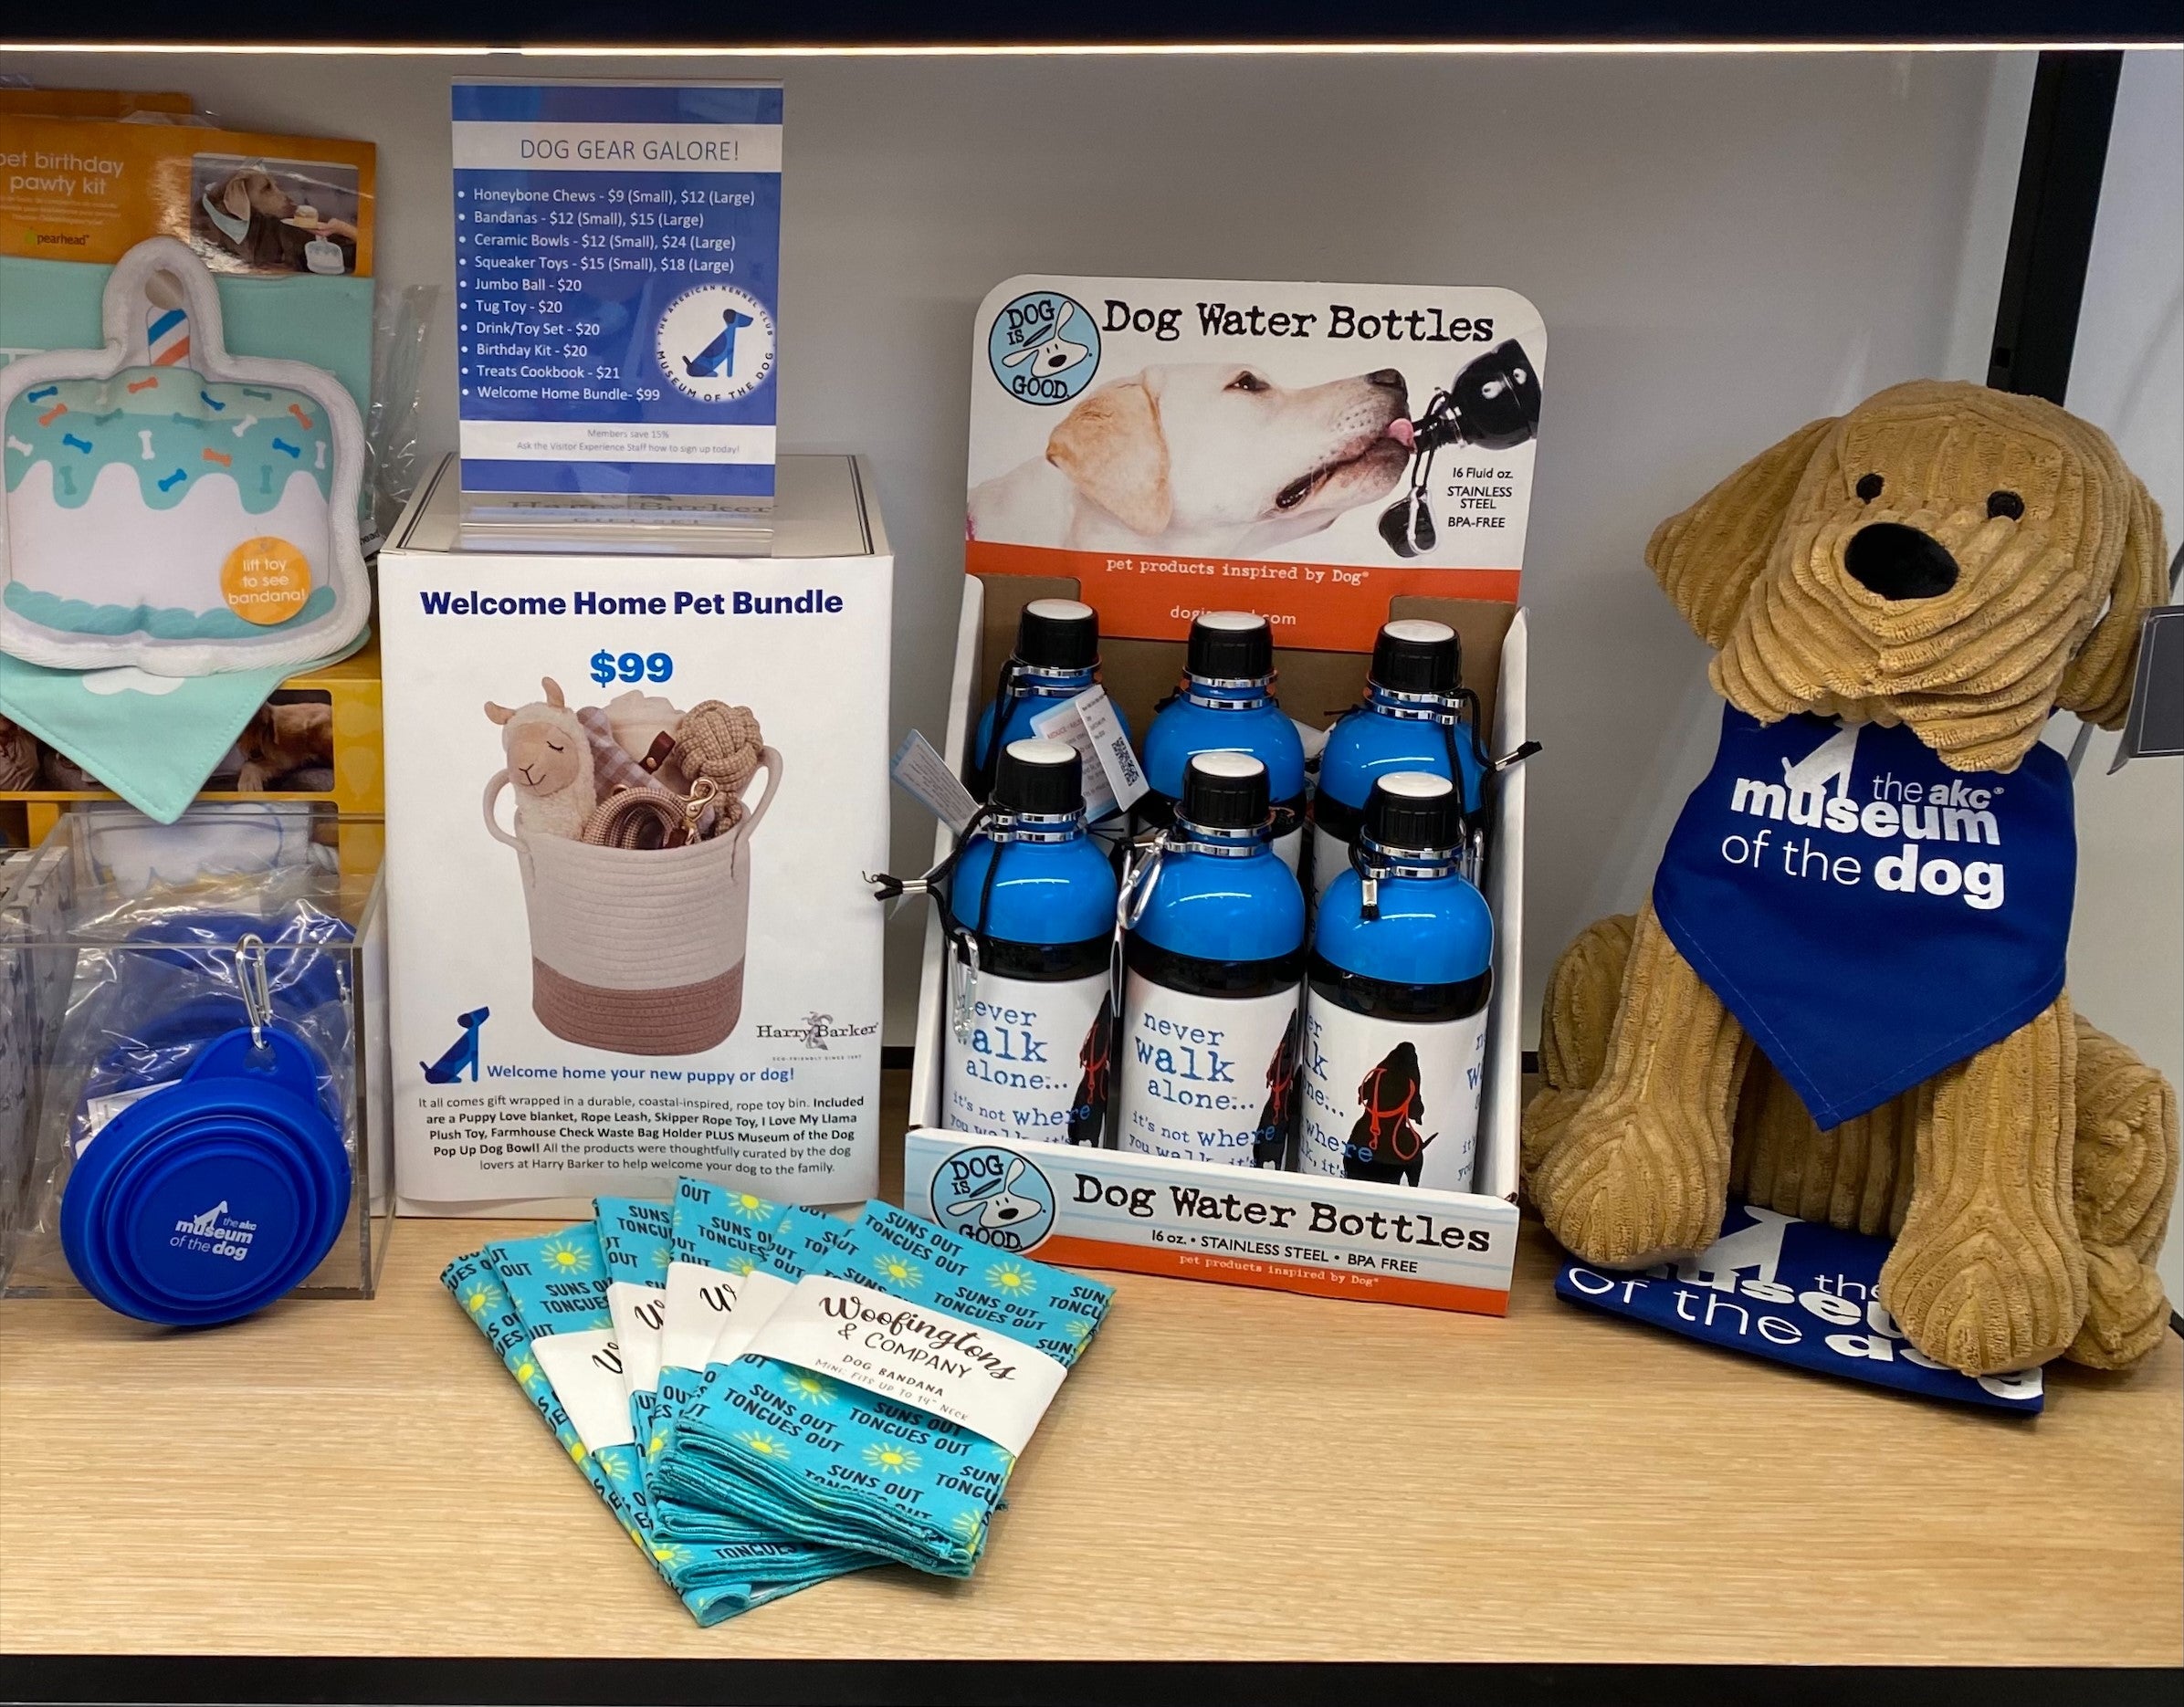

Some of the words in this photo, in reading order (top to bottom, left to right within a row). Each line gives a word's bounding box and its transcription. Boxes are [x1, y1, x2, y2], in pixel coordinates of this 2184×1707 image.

[521, 140, 569, 159] DOG
[577, 141, 635, 160] GEAR
[643, 141, 739, 161] GALORE!
[35, 152, 123, 177] birthday
[10, 175, 77, 196] pawty
[82, 176, 106, 195] kit
[474, 189, 549, 204] Honeybone
[553, 190, 595, 202] Chews
[608, 190, 624, 203] $9
[628, 190, 677, 204] (Small),
[681, 190, 705, 204] $12
[709, 191, 755, 206] (Large)
[474, 211, 537, 225] Bandanas
[550, 212, 573, 225] $12
[577, 212, 625, 227] (Small),
[630, 213, 654, 226] $15
[658, 213, 704, 228] (Large)
[474, 234, 528, 246] Ceramic
[531, 235, 570, 247] Bowls
[582, 235, 605, 248] $12
[610, 235, 658, 250] (Small),
[662, 236, 686, 249] $24
[690, 236, 736, 250] (Large)
[475, 257, 536, 270] Squeaker
[538, 257, 568, 270] Toys
[581, 257, 604, 270] $15
[608, 257, 656, 272] (Small),
[661, 257, 685, 271] $18
[688, 258, 734, 273] (Large)
[475, 278, 519, 291] Jumbo
[522, 278, 545, 291] Ball
[558, 278, 582, 292] $20
[476, 299, 499, 315] Tug
[502, 300, 526, 315] Toy
[538, 300, 562, 314] $20
[1007, 300, 1055, 330] DOG
[477, 321, 541, 338] Drink/Toy
[544, 323, 564, 336] Set
[575, 322, 600, 337] $20
[1102, 299, 1182, 341] Dog
[1196, 302, 1317, 339] Water
[1328, 305, 1494, 342] Bottles
[1007, 329, 1024, 346] IS
[477, 343, 530, 358] Birthday
[534, 344, 551, 357] Kit
[563, 344, 587, 358] $20
[477, 365, 517, 378] Treats
[520, 365, 583, 379] Cookbook
[596, 366, 620, 380] $21
[656, 351, 697, 398] MUSEUM
[704, 393, 721, 403] OF
[729, 379, 754, 400] THE
[756, 351, 772, 380] DOG
[478, 386, 538, 400] Welcome
[541, 387, 580, 400] Home
[583, 388, 633, 401] Bundle-
[636, 388, 659, 402] $99
[1012, 374, 1070, 400] GOOD.
[587, 429, 627, 437] Members
[652, 430, 668, 438] 15%
[534, 442, 547, 450] the
[550, 442, 577, 451] Visitor
[580, 443, 625, 454] Experience
[627, 443, 646, 452] Staff
[648, 444, 667, 453] how
[668, 445, 678, 453] to
[680, 445, 697, 455] sign
[699, 446, 710, 455] up
[712, 445, 740, 455] today!
[1452, 467, 1464, 478] 16
[1466, 467, 1493, 479] Fluid
[1447, 486, 1512, 498] STAINLESS
[1461, 498, 1496, 510] STEEL
[1448, 517, 1505, 529] BPA-FREE
[243, 560, 260, 571] lift
[265, 559, 287, 571] toy
[1107, 558, 1133, 574] pet
[1139, 560, 1214, 577] products
[1222, 563, 1298, 580] inspired
[1306, 567, 1325, 583] by
[243, 576, 257, 588] to
[263, 575, 289, 586] see
[229, 589, 304, 604] bandana!
[420, 592, 566, 615] Welcome
[573, 592, 667, 614] Home
[674, 591, 724, 614] Pet
[732, 589, 843, 613] Bundle
[590, 649, 673, 687] $99
[1873, 772, 1923, 802] the
[1730, 777, 2000, 845] museum
[1722, 829, 1772, 867] of
[1782, 838, 1861, 885] the
[1874, 843, 2004, 910] dog
[756, 1025, 810, 1042] Harry
[1143, 1012, 1224, 1046] never
[1135, 1035, 1234, 1083] walk
[487, 1064, 557, 1079] Welcome
[562, 1065, 605, 1079] home
[611, 1068, 646, 1082] your
[650, 1069, 682, 1081] new
[686, 1071, 735, 1084] puppy
[740, 1070, 757, 1082] or
[761, 1068, 794, 1084] dog!
[419, 1098, 426, 1109] It
[429, 1098, 444, 1109] all
[446, 1098, 484, 1108] comes
[488, 1095, 507, 1109] gift
[509, 1096, 560, 1109] wrapped
[563, 1097, 574, 1107] in
[578, 1099, 584, 1107] a
[588, 1096, 635, 1109] durable,
[638, 1097, 732, 1112] coastal-inspired,
[736, 1099, 763, 1112] rope
[766, 1098, 785, 1111] toy
[788, 1098, 809, 1109] bin.
[814, 1097, 864, 1107] Included
[949, 1155, 1004, 1182] DOG
[952, 1180, 971, 1198] IS
[1074, 1174, 1156, 1219] Dog
[1171, 1187, 1297, 1231] Water
[1308, 1202, 1491, 1253] Bottles
[175, 1219, 254, 1245] museum
[224, 1218, 238, 1229] the
[238, 1220, 257, 1231] akc
[884, 1212, 929, 1239] SUNS
[929, 1232, 964, 1257] OUT
[170, 1234, 185, 1249] of
[187, 1239, 211, 1253] the
[213, 1241, 248, 1262] dog
[865, 1214, 931, 1262] TONGUES
[934, 1253, 969, 1277] OUT
[959, 1224, 1023, 1251] GOOD.
[1151, 1230, 1163, 1242] 16
[1166, 1233, 1187, 1244] oz.
[1201, 1236, 1279, 1259] STAINLESS
[1284, 1245, 1328, 1263] STEEL
[1347, 1254, 1375, 1267] BPA
[1380, 1257, 1418, 1273] FREE
[819, 1293, 1016, 1381] Woofingtons
[838, 1324, 858, 1340] &
[865, 1333, 973, 1379] COMPANY
[842, 1355, 872, 1371] DOG
[878, 1367, 944, 1398] BANDANA
